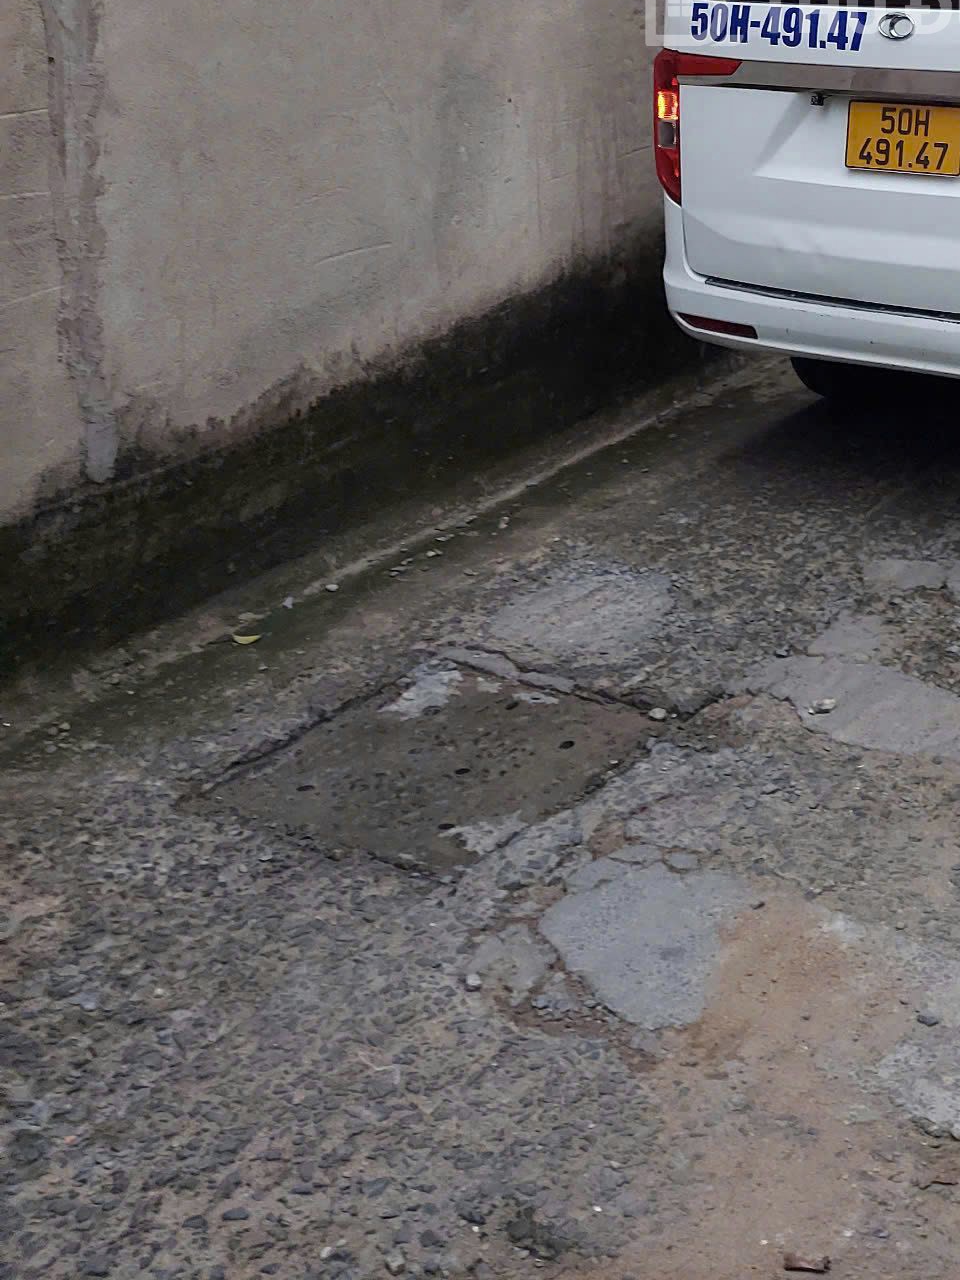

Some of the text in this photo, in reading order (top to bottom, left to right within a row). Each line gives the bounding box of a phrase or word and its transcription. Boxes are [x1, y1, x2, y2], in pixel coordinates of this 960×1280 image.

[690, 3, 868, 52] 50H-491.47
[880, 105, 931, 135] 50H
[857, 135, 950, 169] 491.47
